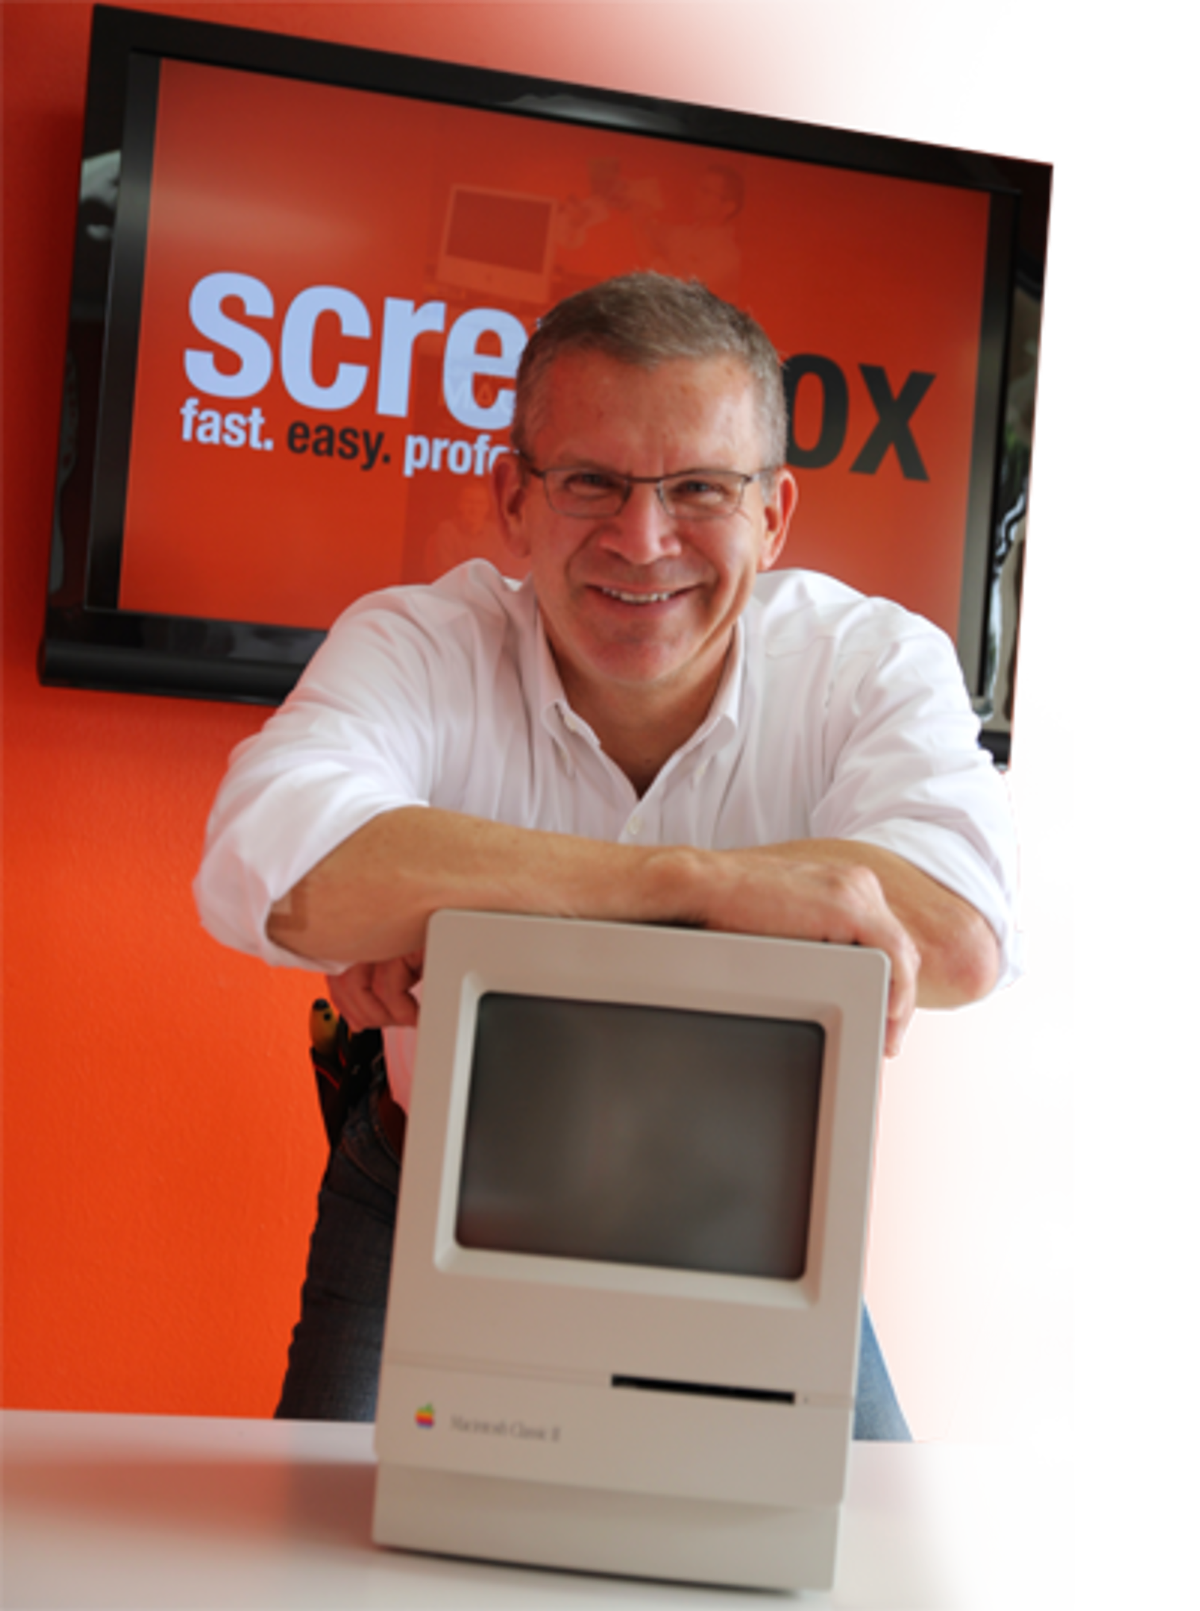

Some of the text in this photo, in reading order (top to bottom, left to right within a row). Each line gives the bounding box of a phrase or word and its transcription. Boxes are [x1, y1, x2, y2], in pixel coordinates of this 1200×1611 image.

[180, 397, 274, 451] fast.
[286, 420, 391, 471] easy.
[184, 271, 937, 482] scre ox
